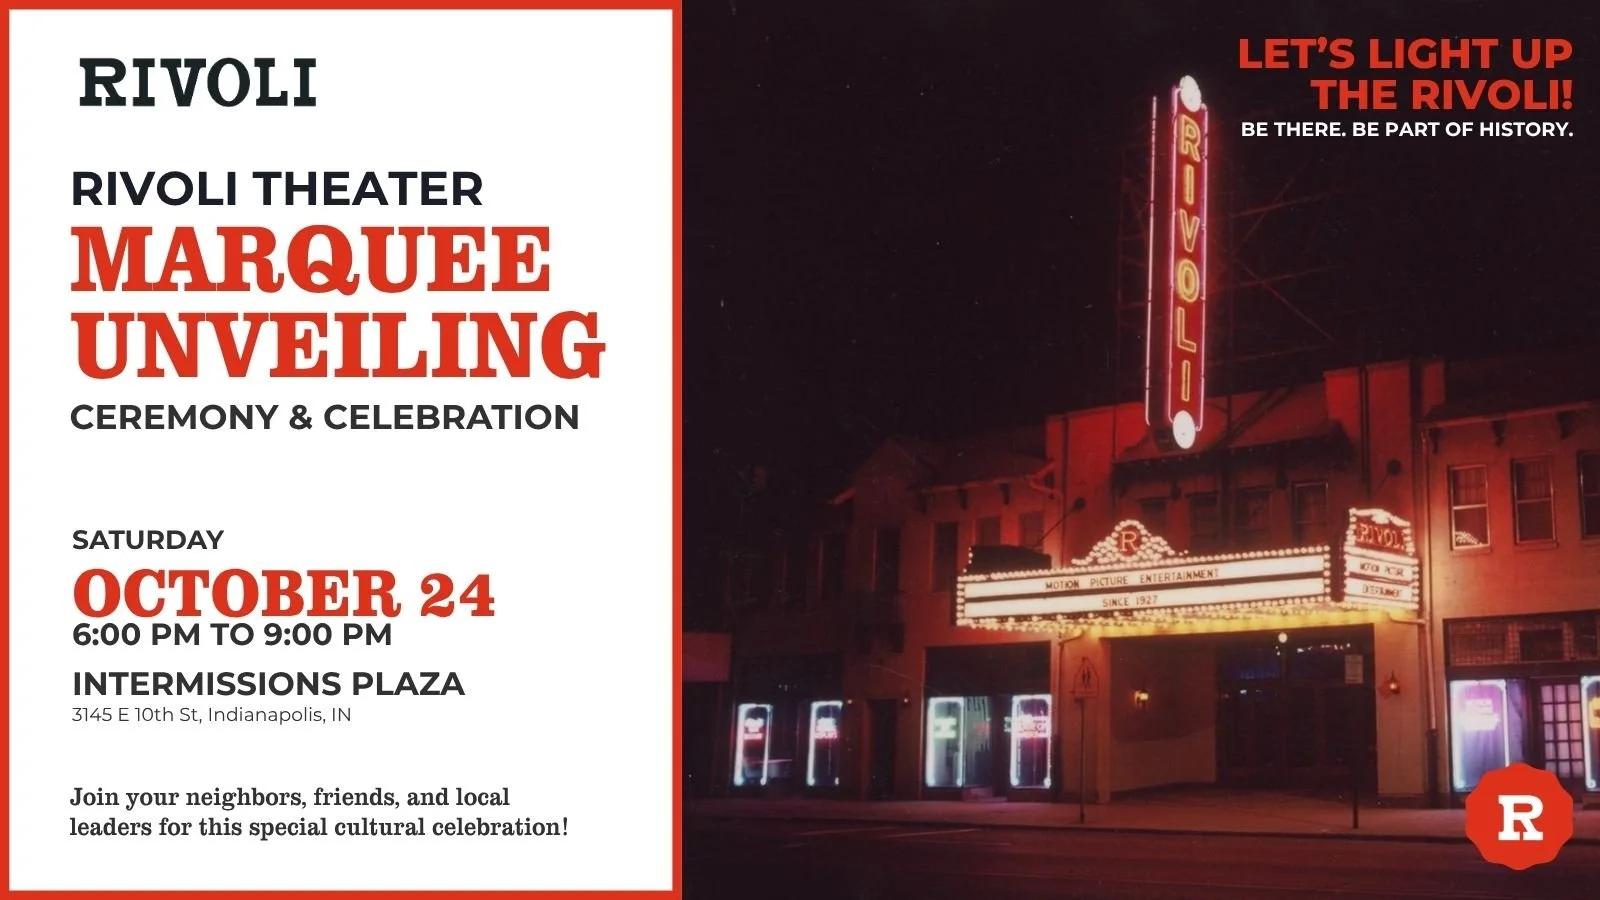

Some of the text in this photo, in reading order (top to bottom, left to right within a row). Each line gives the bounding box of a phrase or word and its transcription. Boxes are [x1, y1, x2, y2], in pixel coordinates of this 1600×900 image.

[1176, 114, 1200, 402] RIVOLI
[1119, 531, 1139, 551] R
[1045, 568, 1219, 590] MOTION PICTURE ENTERTAINMENT
[1102, 595, 1159, 607] SINCE 1927
